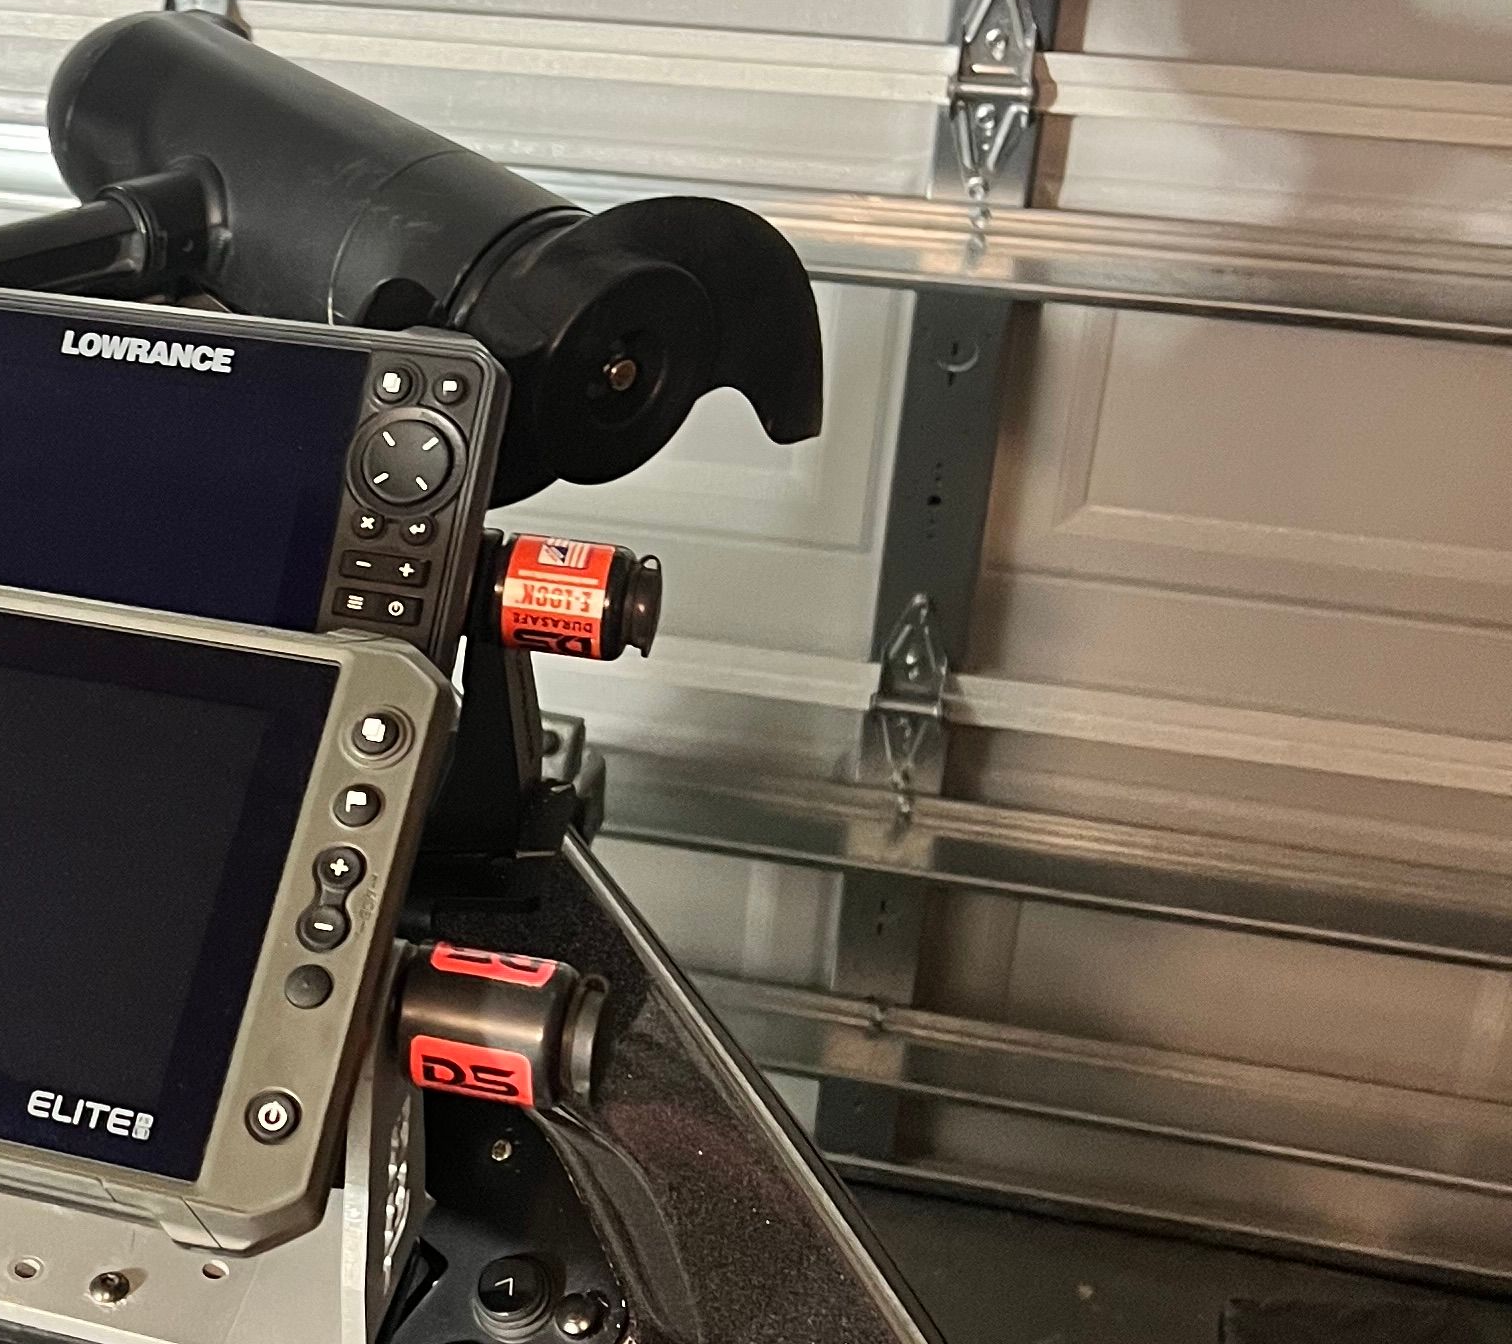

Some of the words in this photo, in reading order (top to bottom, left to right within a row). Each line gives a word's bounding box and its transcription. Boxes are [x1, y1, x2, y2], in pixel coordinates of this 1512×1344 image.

[61, 330, 235, 373] LOWRANCE
[512, 612, 593, 634] DURASAFE
[421, 1054, 520, 1097] DS
[27, 1089, 135, 1137] ELITE
